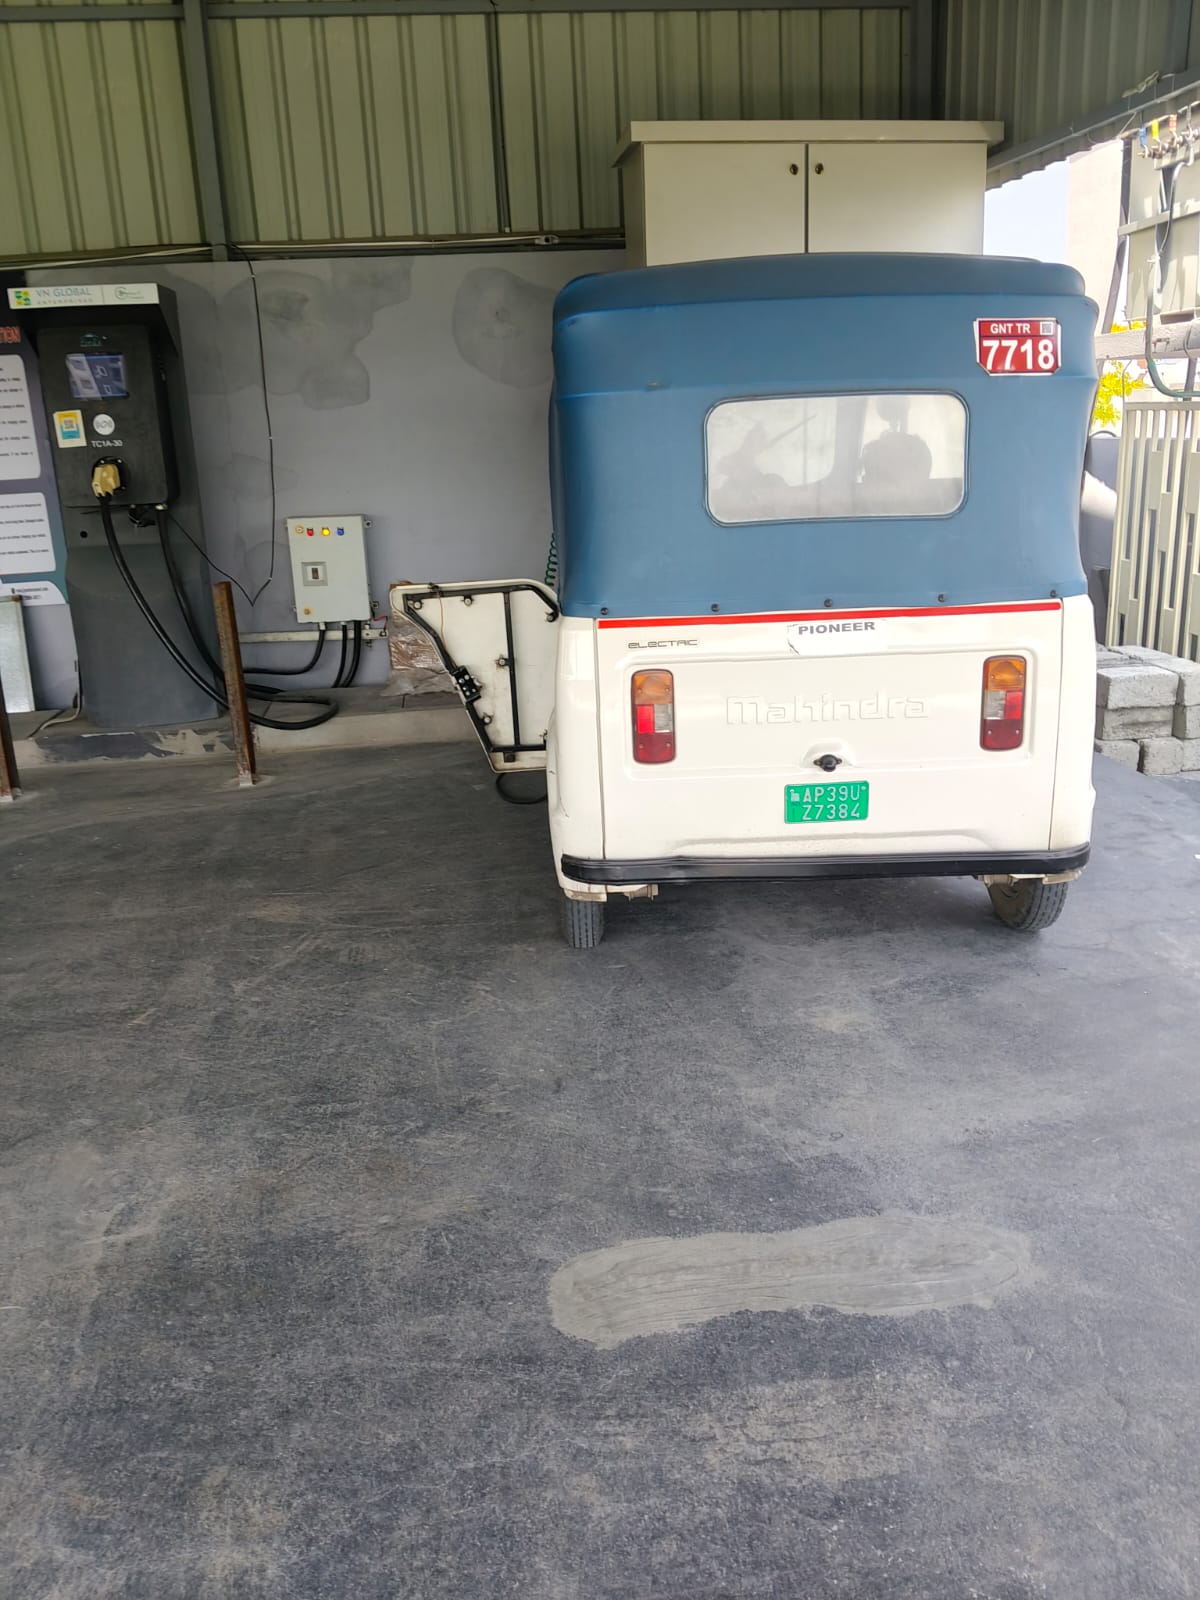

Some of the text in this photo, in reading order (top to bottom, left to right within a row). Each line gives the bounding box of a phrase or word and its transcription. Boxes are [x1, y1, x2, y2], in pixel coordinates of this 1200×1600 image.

[53, 287, 92, 297] GLOBAL
[990, 323, 1031, 334] GNT TR
[982, 339, 1055, 370] 7718
[798, 621, 876, 635] PIONEER
[803, 784, 860, 802] AP39U
[802, 803, 860, 820] Z7384
